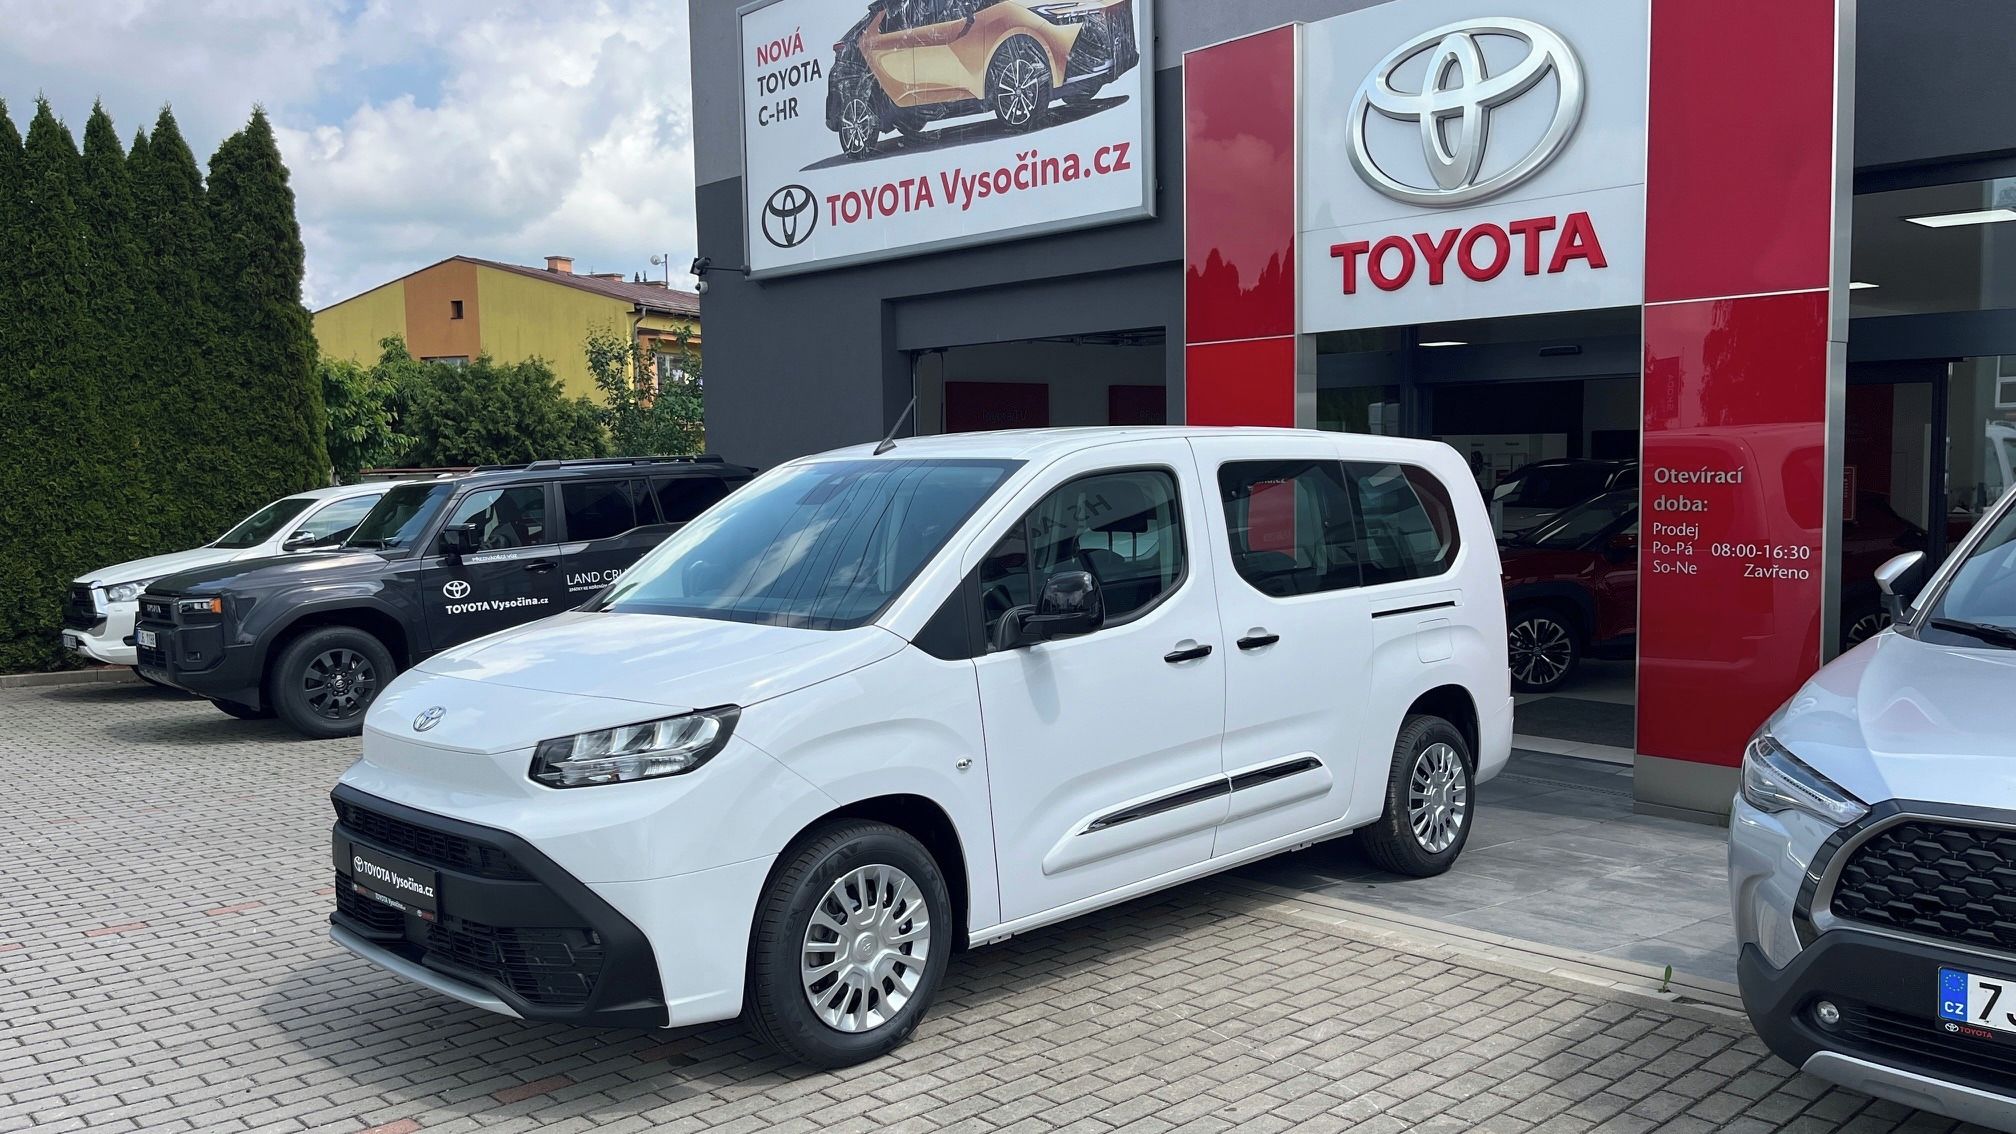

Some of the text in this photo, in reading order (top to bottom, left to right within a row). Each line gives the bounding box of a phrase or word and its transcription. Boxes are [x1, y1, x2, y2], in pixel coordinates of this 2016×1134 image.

[756, 27, 804, 68] NOVÁ
[757, 60, 823, 97] TOYOTA
[758, 97, 799, 127] C-HR
[826, 141, 1132, 227] TOYOTA Vysočina.cz
[1330, 211, 1608, 295] TOYOTA
[1653, 466, 1744, 484] Otevírací
[1653, 495, 1708, 512] doba:
[1653, 522, 1699, 540] Prodej
[1653, 541, 1810, 560] Po-Pá 08:00-16:30
[566, 571, 600, 586] LAND
[1653, 560, 1809, 580] So-Ne Zavřeno
[445, 596, 549, 615] TOYOTA Vysočina.cz
[363, 861, 434, 898] TOYOTA Vysočina.cz
[1944, 1001, 1964, 1015] CZ
[1960, 1026, 1993, 1039] TOYOTA
